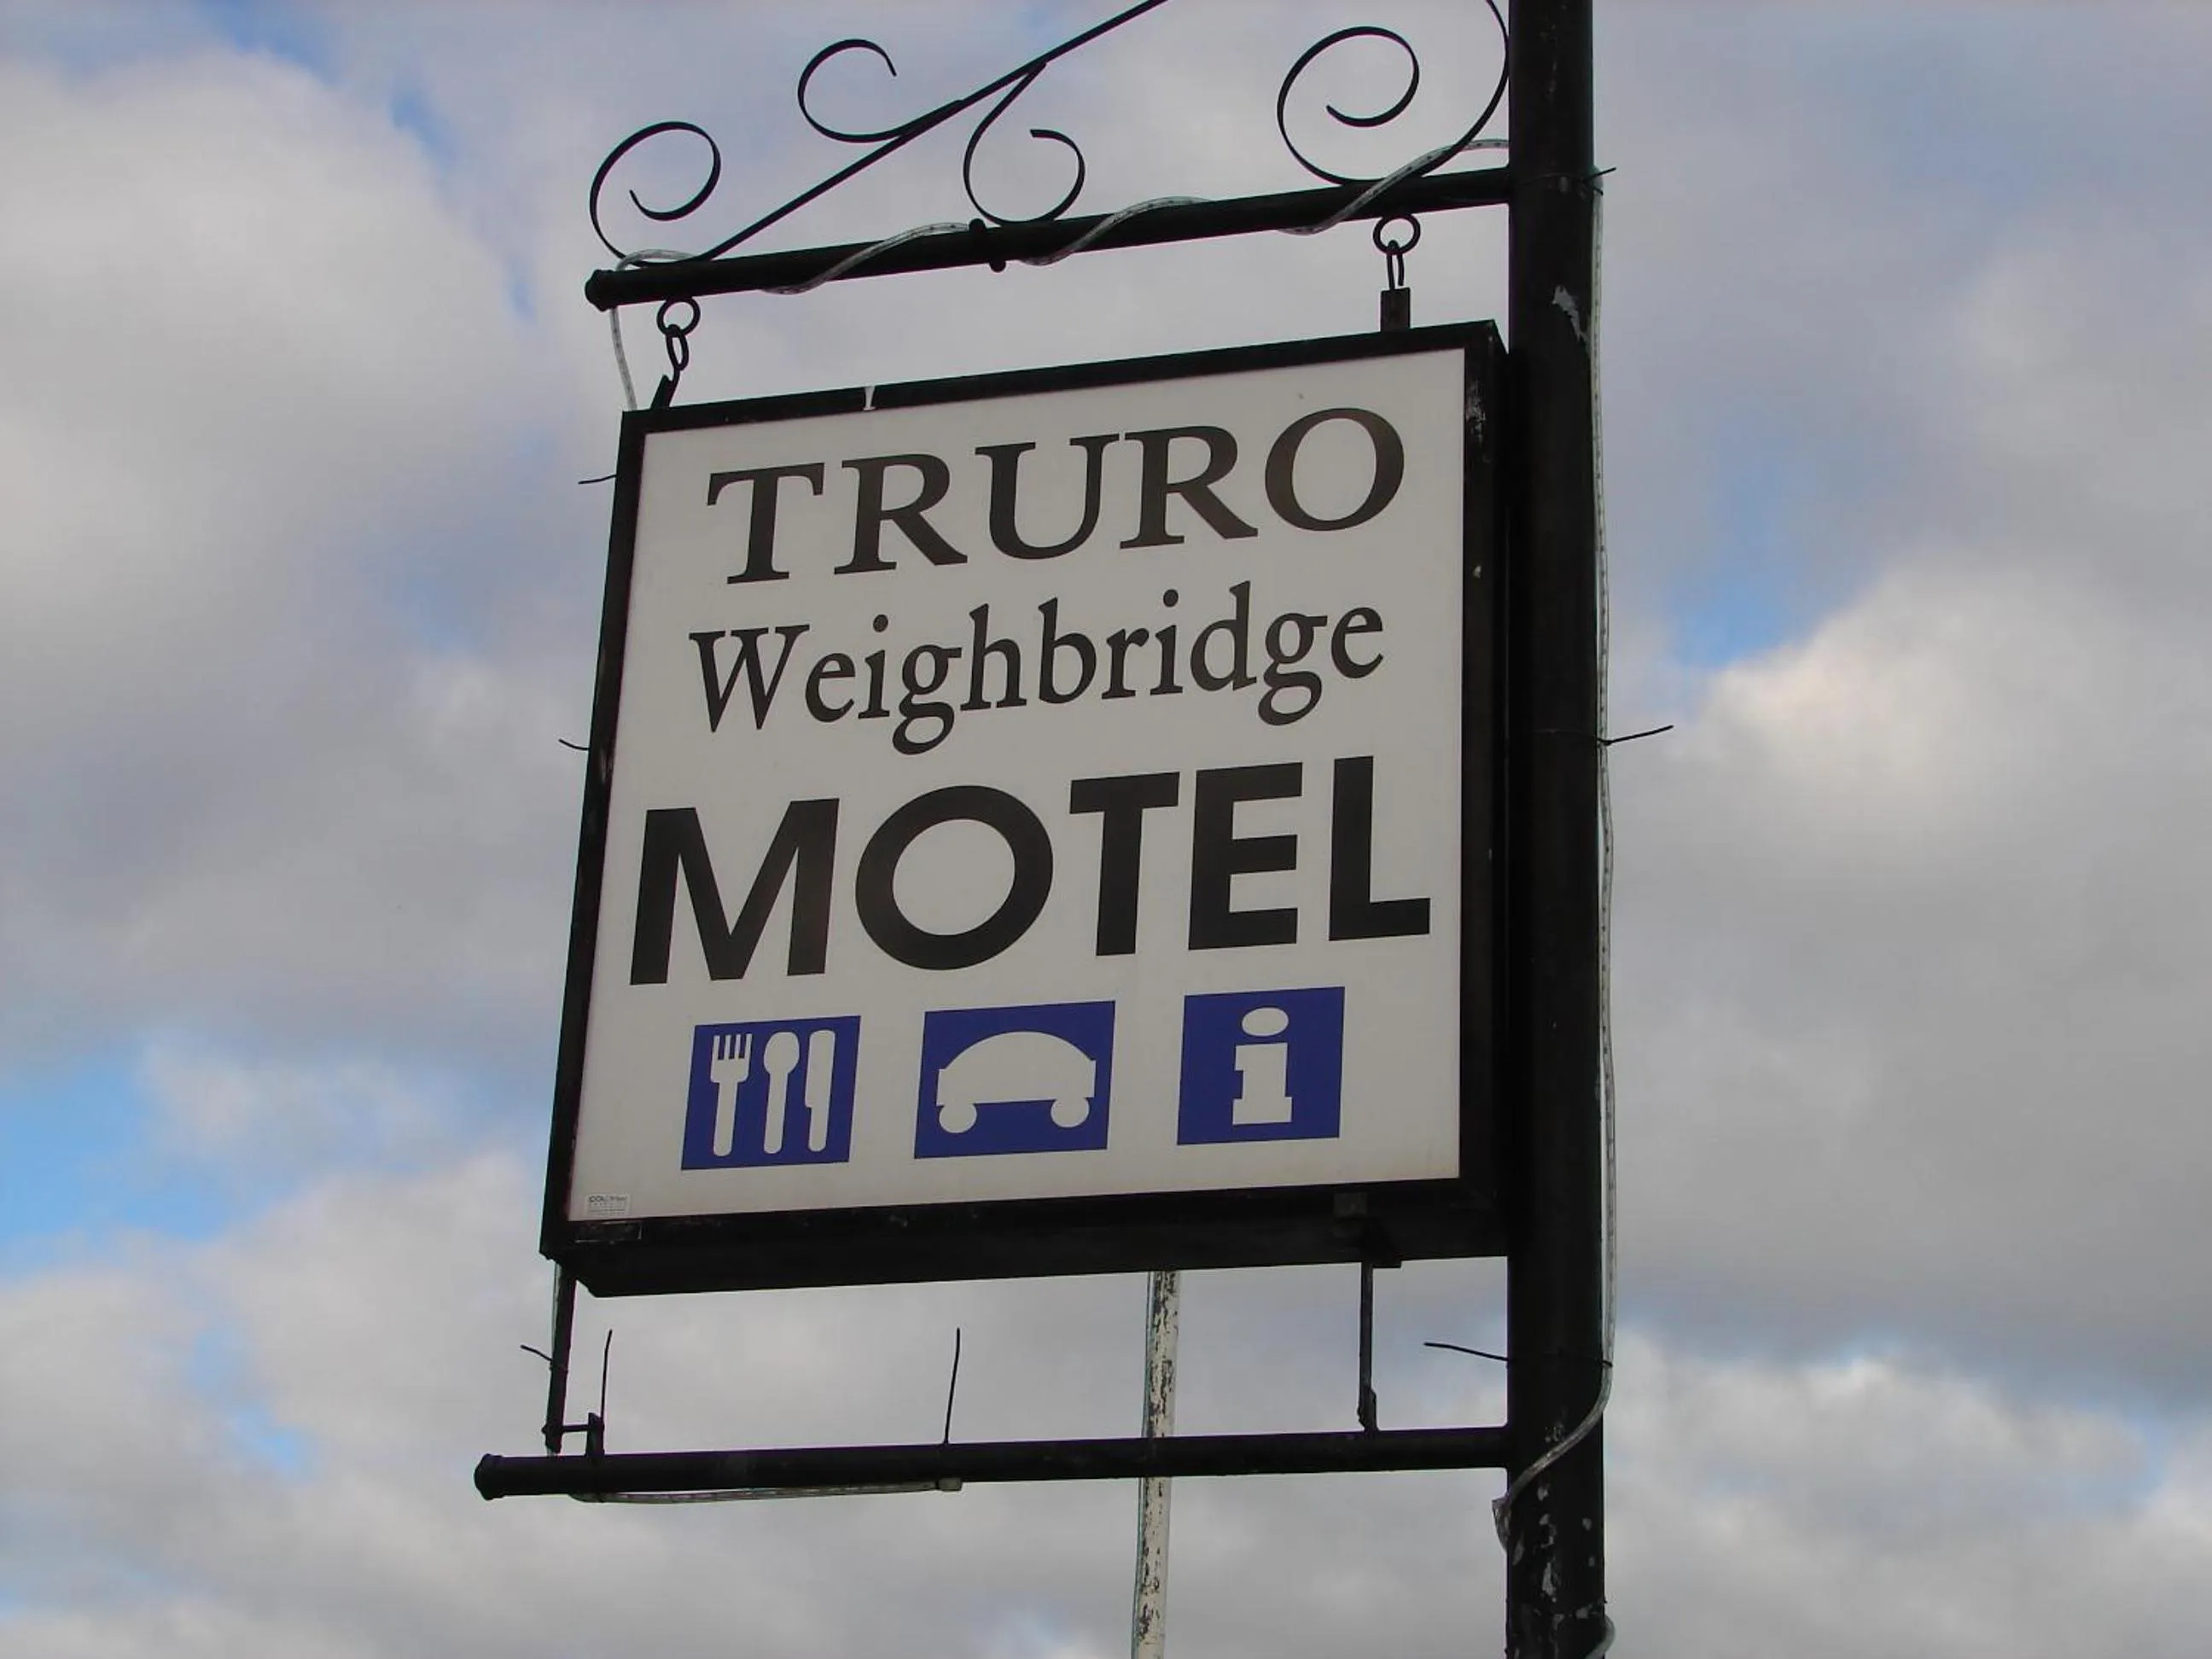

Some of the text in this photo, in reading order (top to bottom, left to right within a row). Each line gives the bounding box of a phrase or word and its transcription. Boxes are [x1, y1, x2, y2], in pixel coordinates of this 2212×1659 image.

[707, 408, 1405, 584] TRURO
[689, 580, 1384, 755] Weighbridge
[630, 755, 1431, 986] MOTEL
